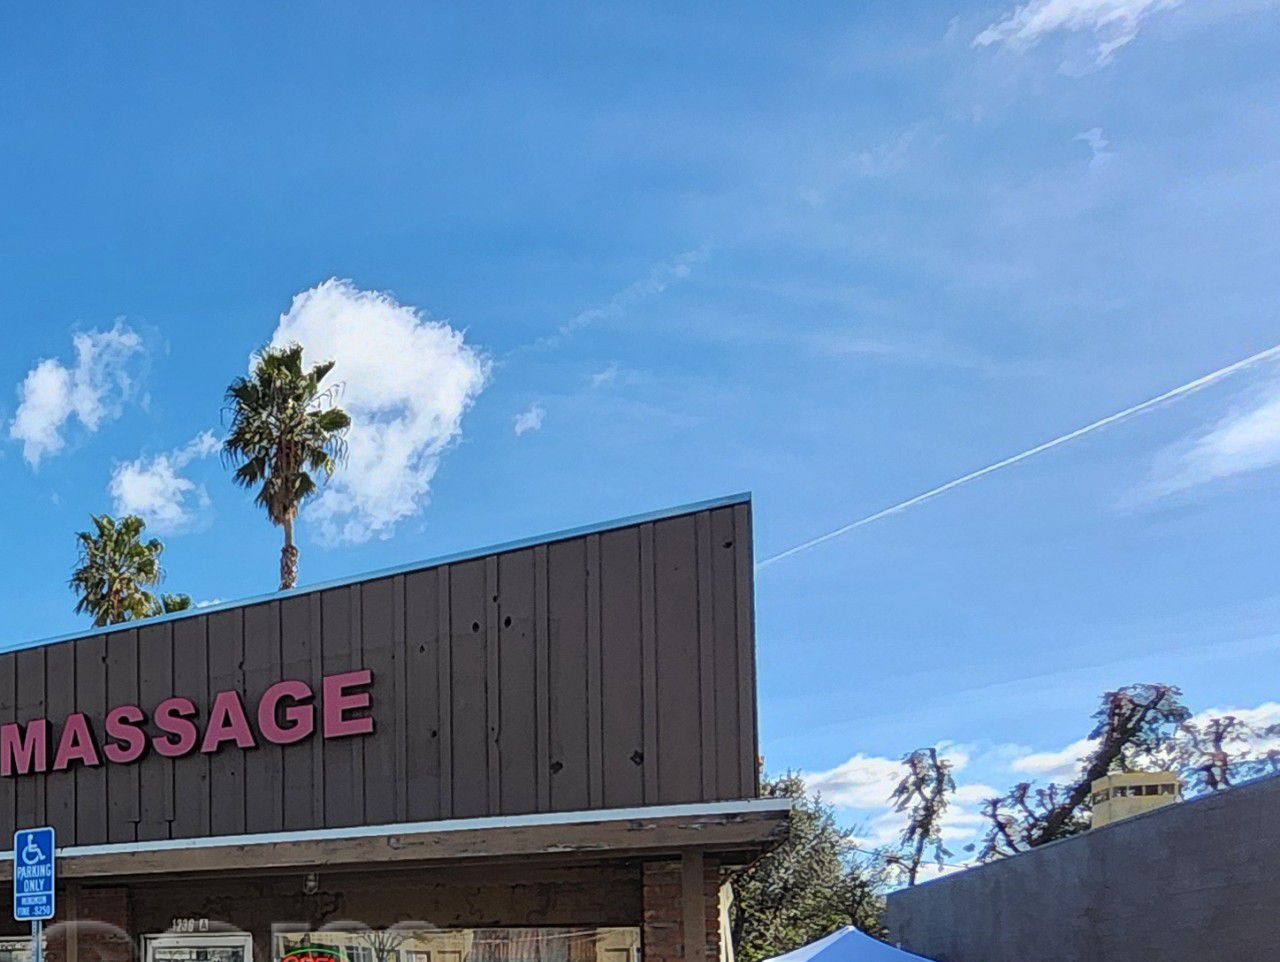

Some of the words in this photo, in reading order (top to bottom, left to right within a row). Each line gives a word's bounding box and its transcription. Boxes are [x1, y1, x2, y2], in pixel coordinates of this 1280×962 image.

[0, 669, 374, 777] MASSAGE
[17, 863, 52, 879] PARKING
[23, 878, 45, 893] ONLY
[172, 917, 195, 932] 1236
[199, 918, 209, 932] A
